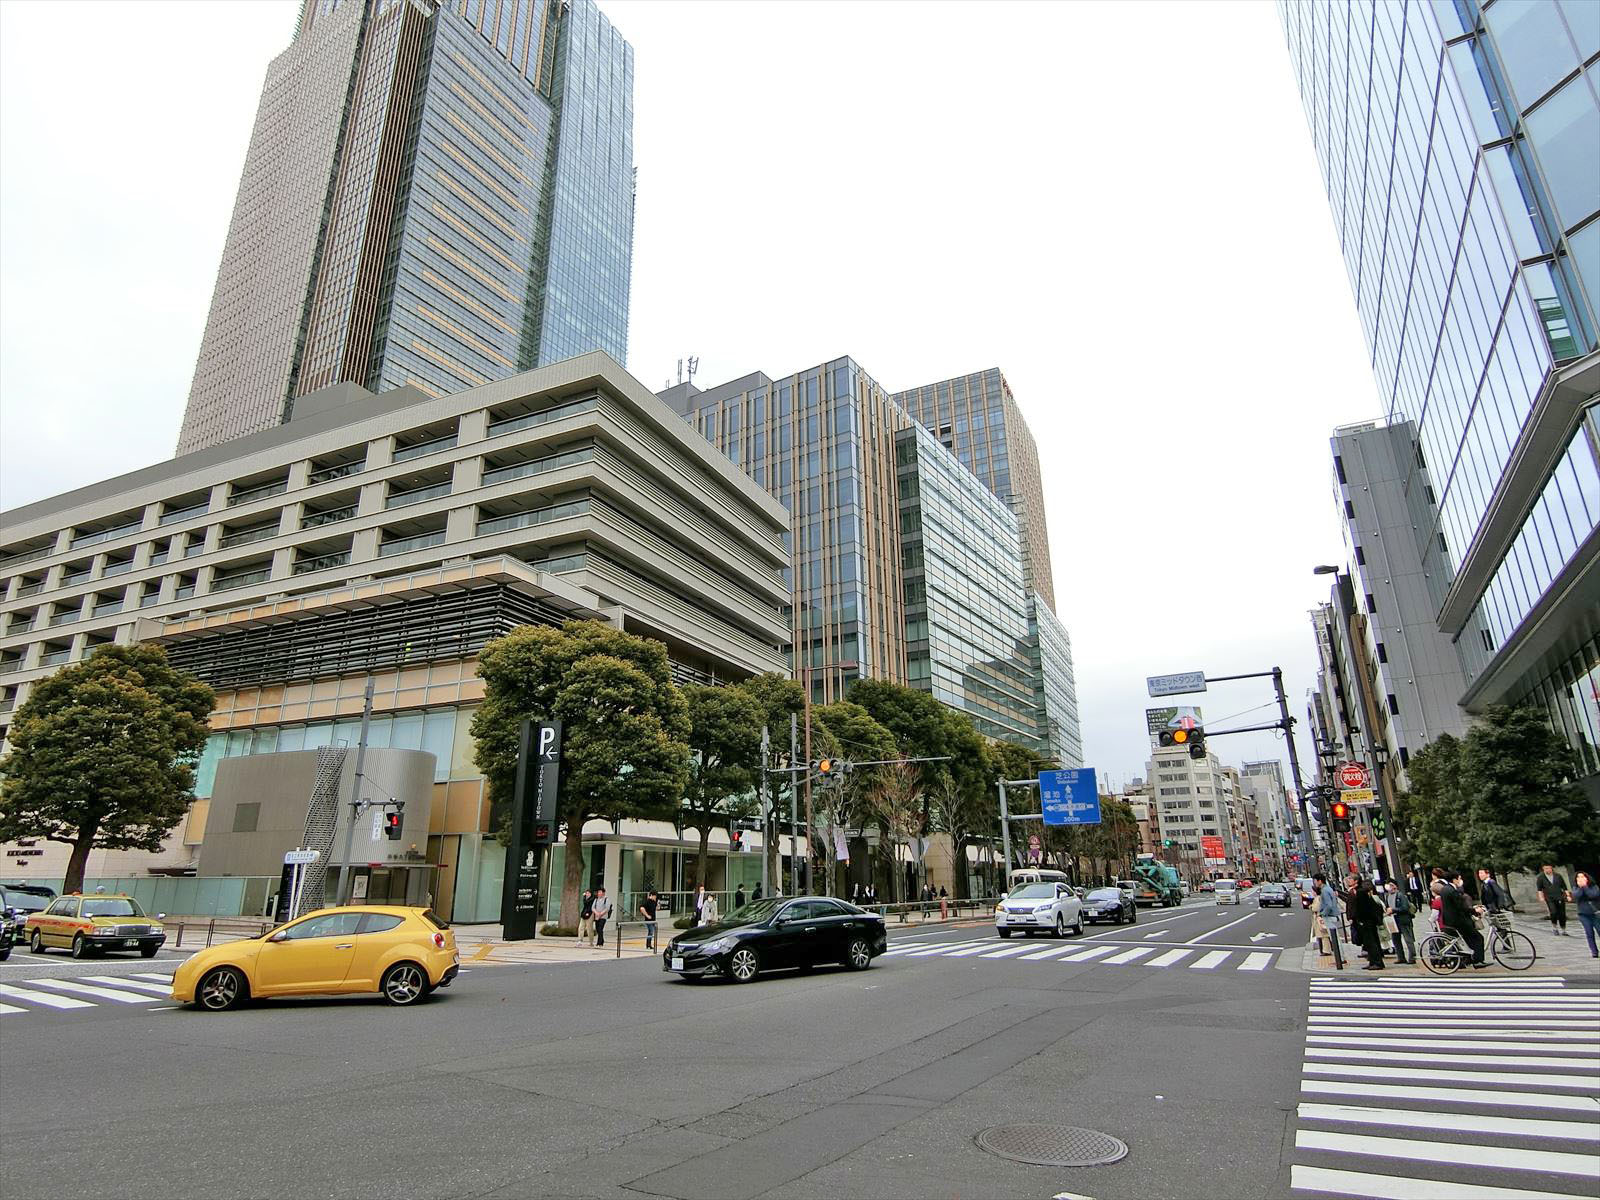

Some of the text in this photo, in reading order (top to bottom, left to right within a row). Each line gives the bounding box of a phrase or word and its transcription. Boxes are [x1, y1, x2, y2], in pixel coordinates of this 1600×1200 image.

[1149, 674, 1203, 688] 東京ミッドタウン西
[539, 727, 555, 756] P
[1055, 771, 1079, 780] 芝公園
[1343, 772, 1362, 781] 消火栓
[535, 788, 543, 820] MIDTOWN
